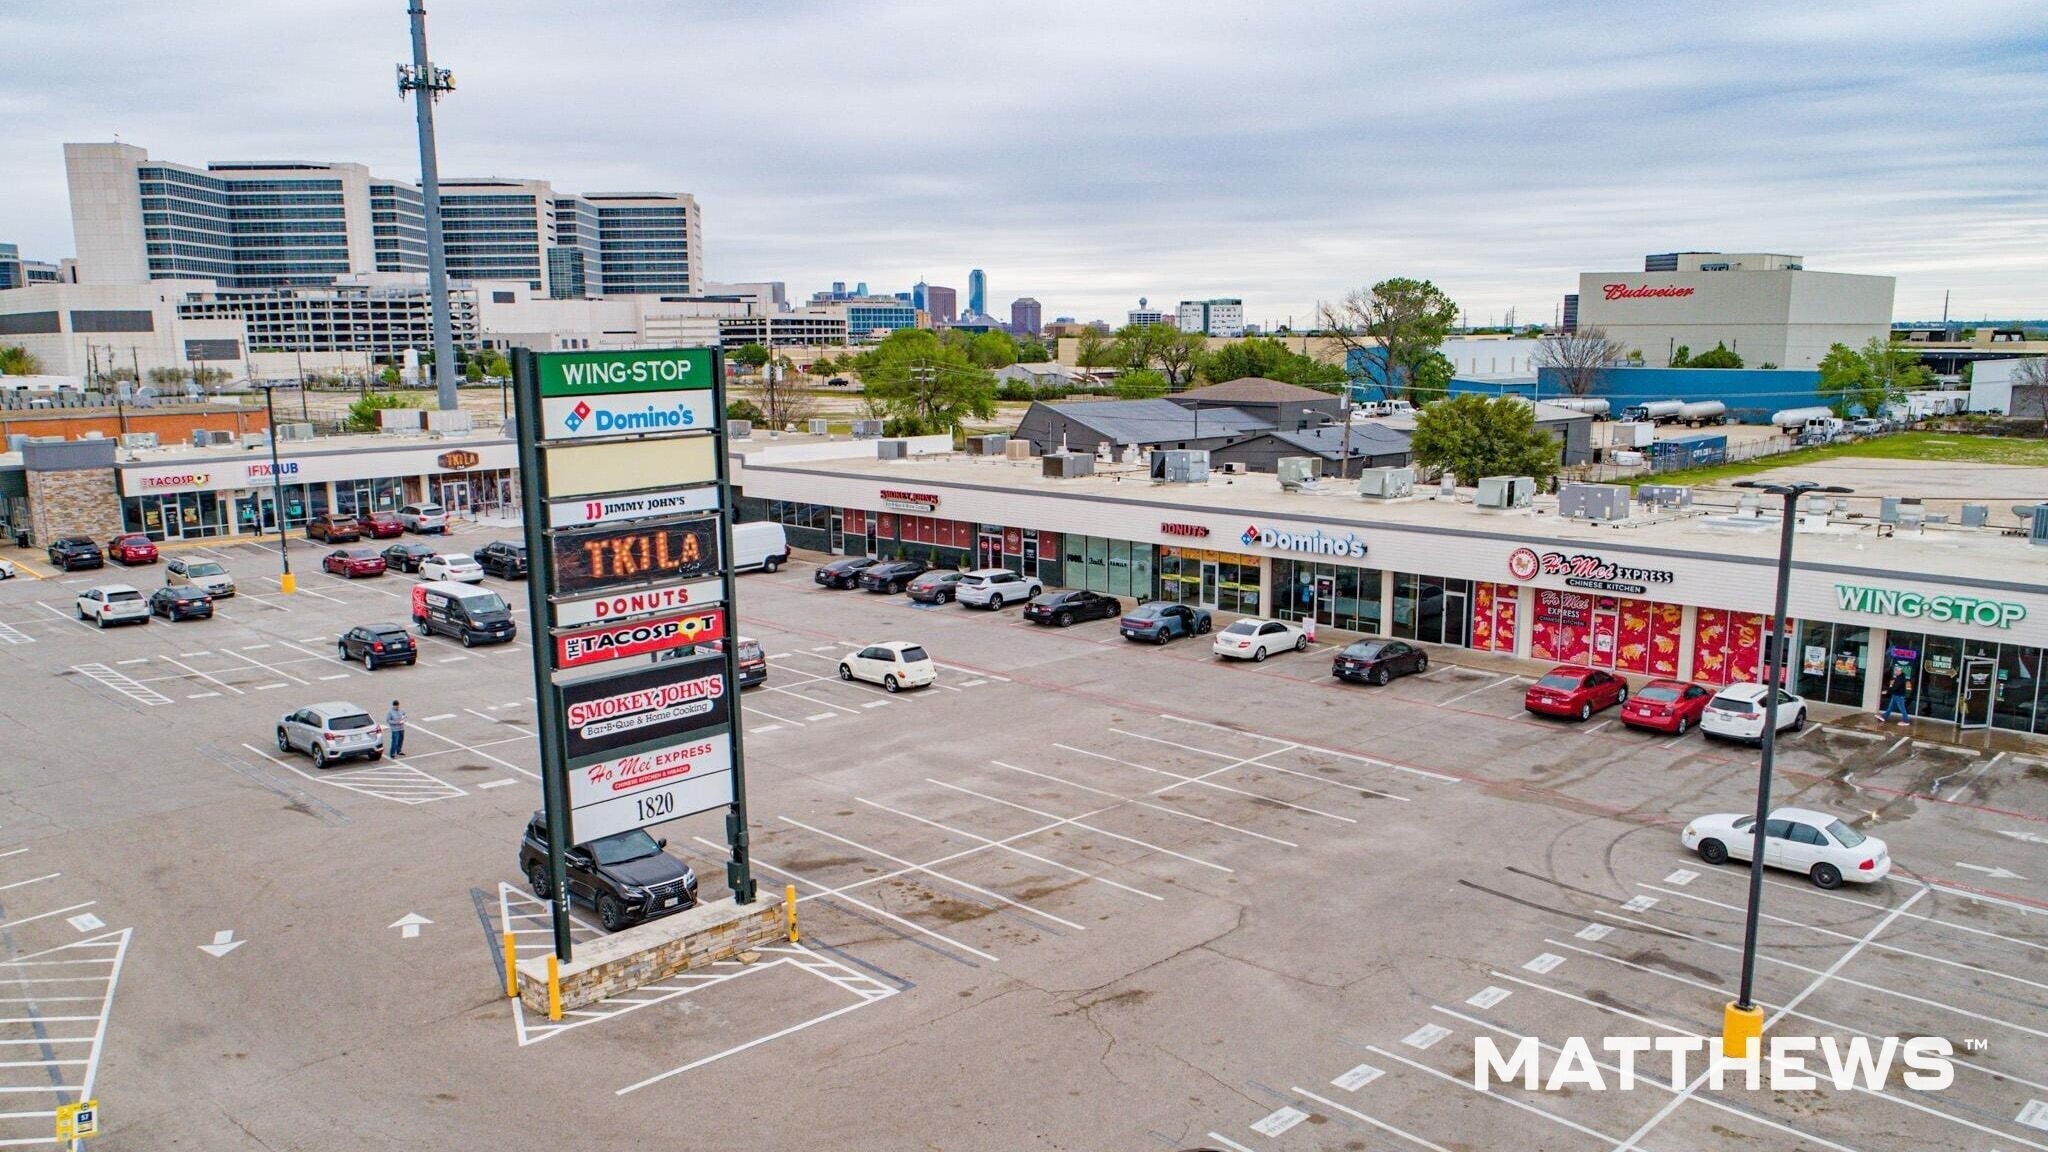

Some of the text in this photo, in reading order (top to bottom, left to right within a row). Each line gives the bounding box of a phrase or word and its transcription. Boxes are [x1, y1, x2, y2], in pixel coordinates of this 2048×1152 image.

[1603, 283, 1694, 300] Budweiser
[595, 404, 694, 431] Domino's
[604, 501, 644, 515] JIMMY
[648, 496, 686, 510] JOHN'S
[1161, 522, 1208, 538] DONUTS
[1260, 528, 1366, 558] Domino's
[584, 531, 700, 578] TKILA
[1618, 567, 1673, 584] EXPRESS
[1569, 580, 1642, 593] CHINESE KITCHEN
[595, 588, 689, 618] DONUTS
[1547, 608, 1580, 618] EXPRESS
[567, 639, 581, 660] THE
[570, 676, 723, 726] SMOKEY JOHN'S
[646, 710, 671, 723] Home
[672, 703, 708, 718] Cooking
[588, 763, 613, 785] Ho
[656, 744, 712, 766] EXPRESS
[637, 791, 674, 821] 1820
